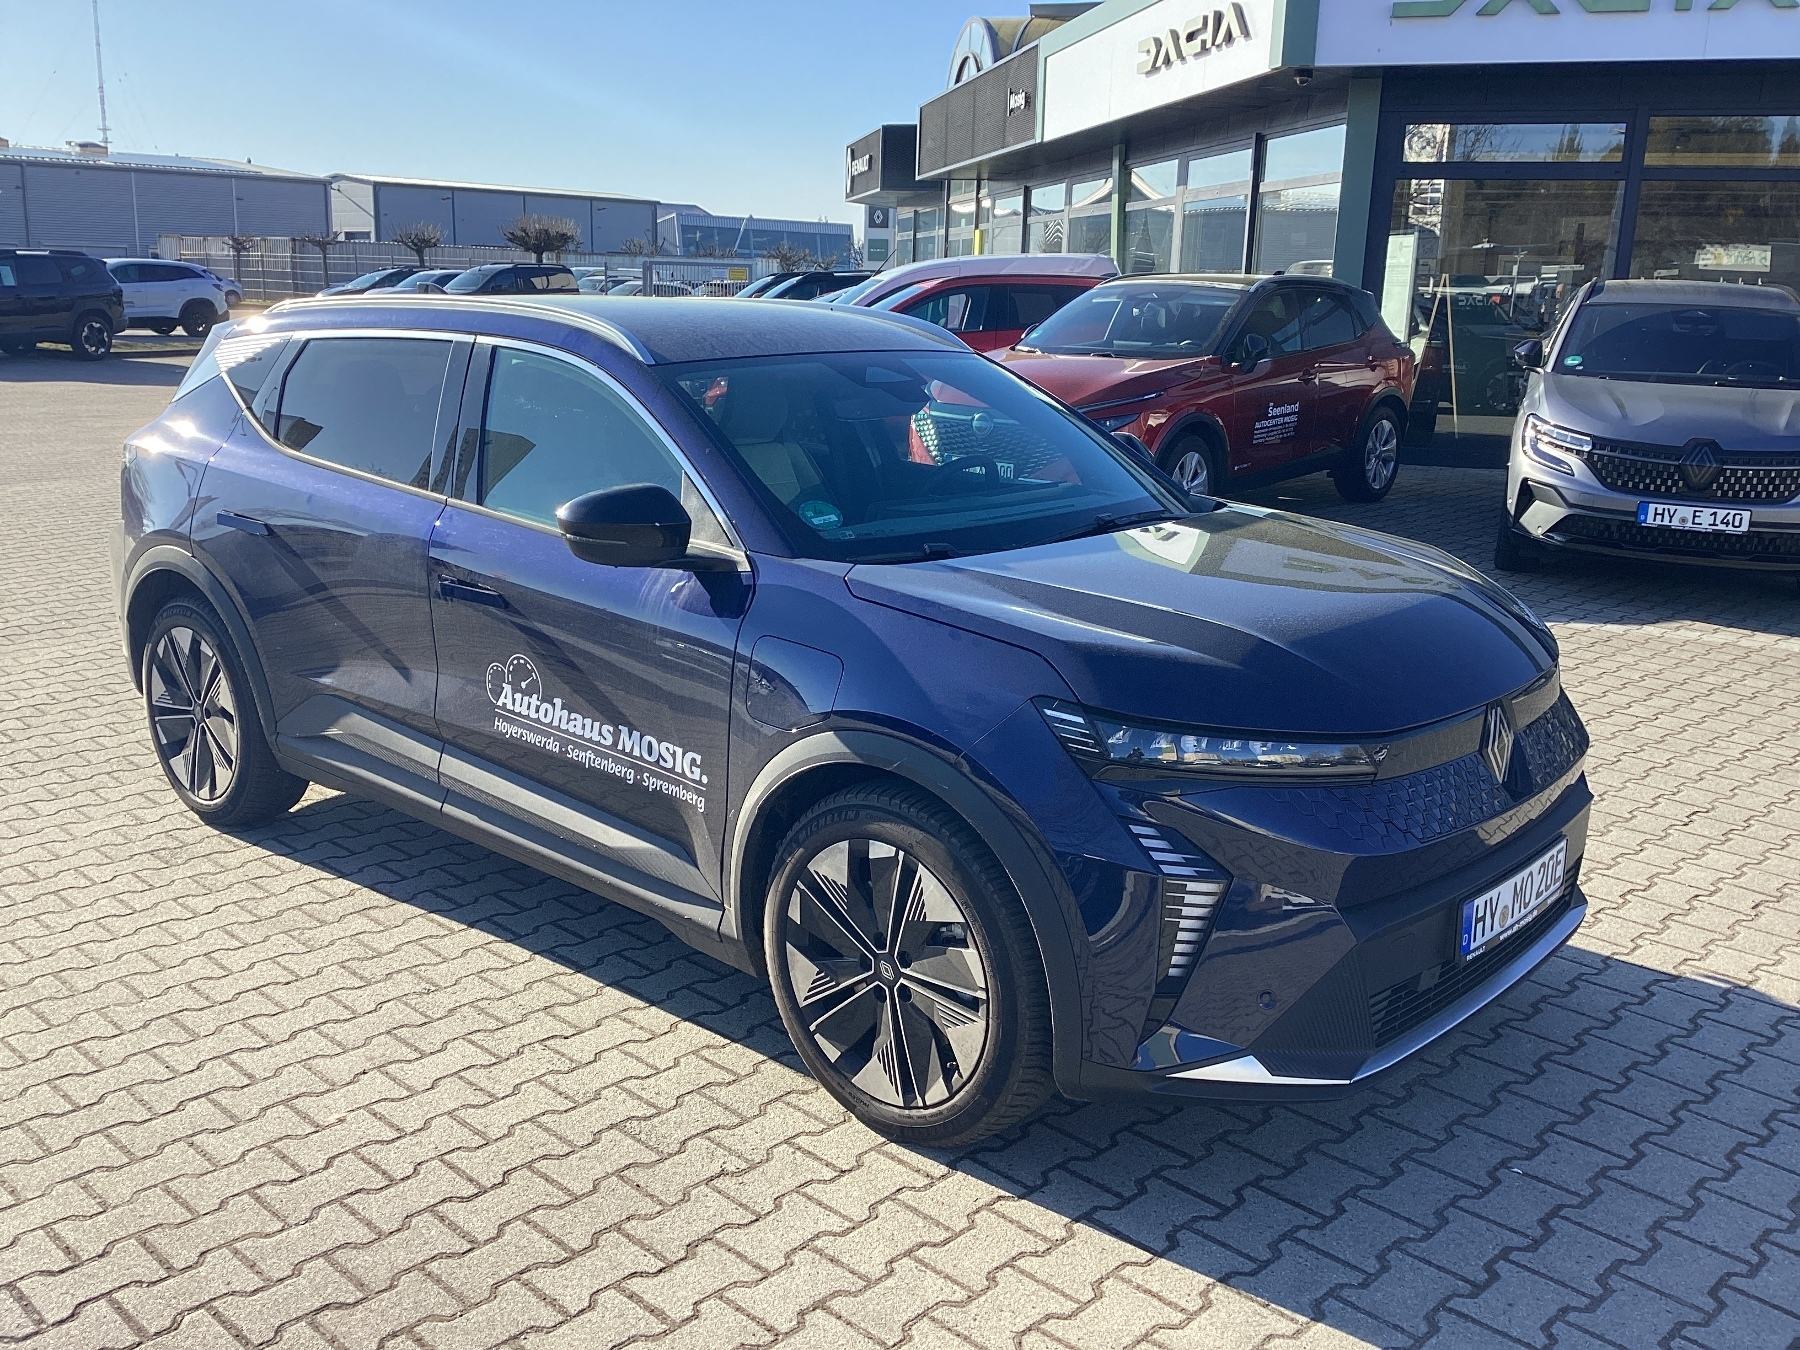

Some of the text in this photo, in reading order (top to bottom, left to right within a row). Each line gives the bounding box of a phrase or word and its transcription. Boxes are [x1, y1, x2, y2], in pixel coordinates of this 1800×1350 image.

[1137, 2, 1246, 75] DACIA
[852, 154, 870, 176] RENAULT
[1267, 401, 1300, 417] Seenland
[1652, 506, 1678, 524] HY
[1691, 509, 1704, 526] E
[1708, 511, 1744, 529] 140
[496, 682, 709, 784] Autohaus MOSIG.
[494, 716, 706, 813] Hoyerswerda Senftenberg Spremberg
[1472, 891, 1501, 943] HY
[1511, 870, 1534, 919] MO
[1462, 933, 1469, 946] D
[1466, 945, 1486, 962] RENAULT
